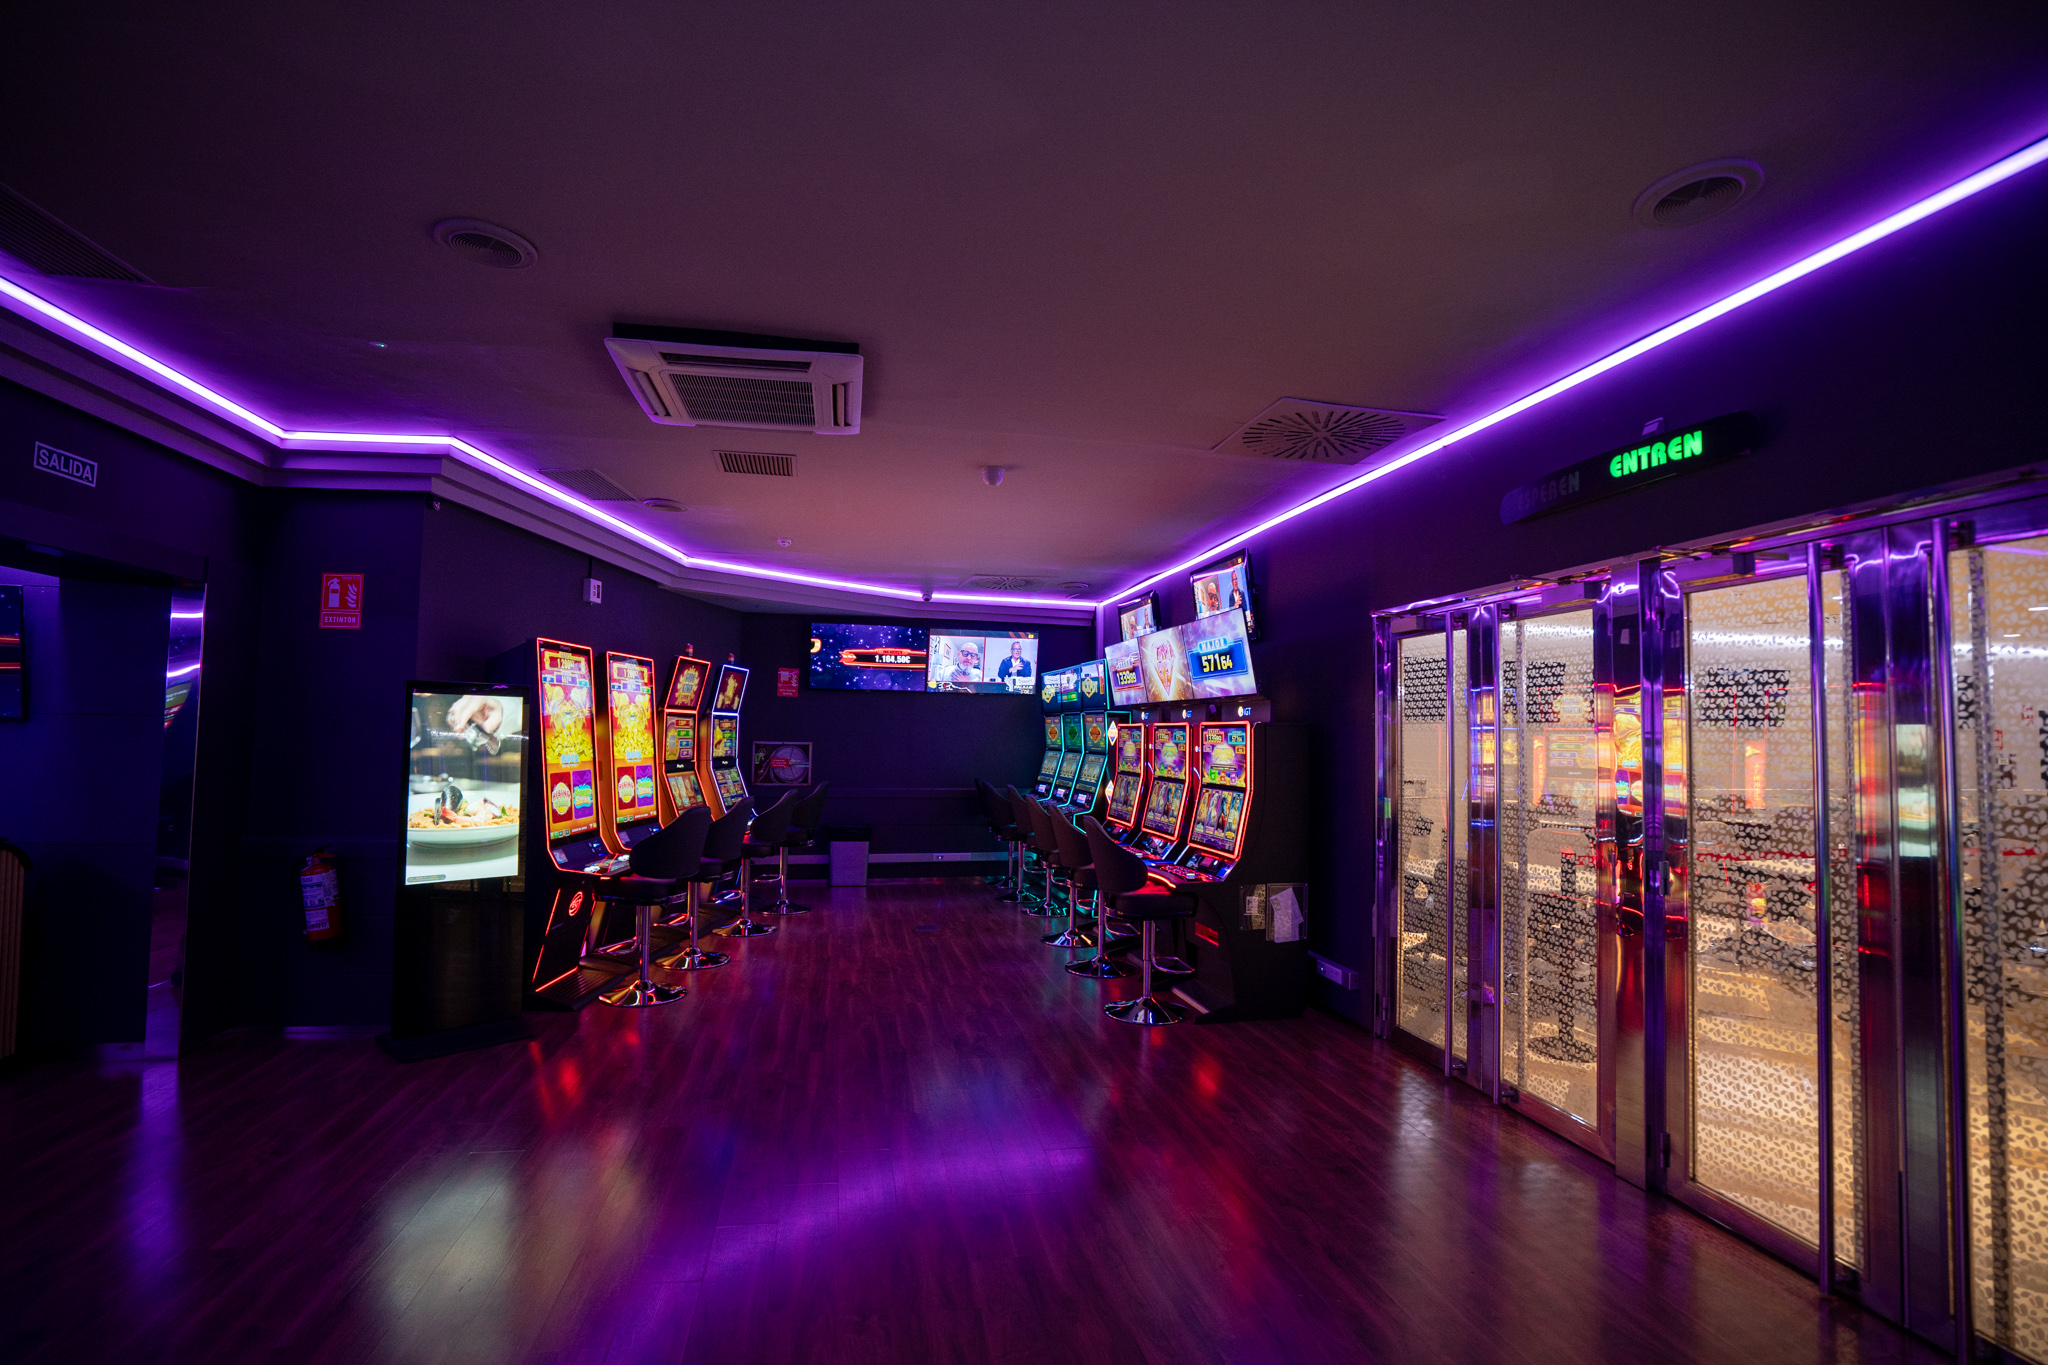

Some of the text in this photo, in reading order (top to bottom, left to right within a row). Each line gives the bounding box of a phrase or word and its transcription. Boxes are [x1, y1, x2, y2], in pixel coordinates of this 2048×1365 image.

[39, 449, 92, 482] SALIDA
[1609, 430, 1703, 478] ENTREN
[1201, 638, 1225, 651] MAJOR
